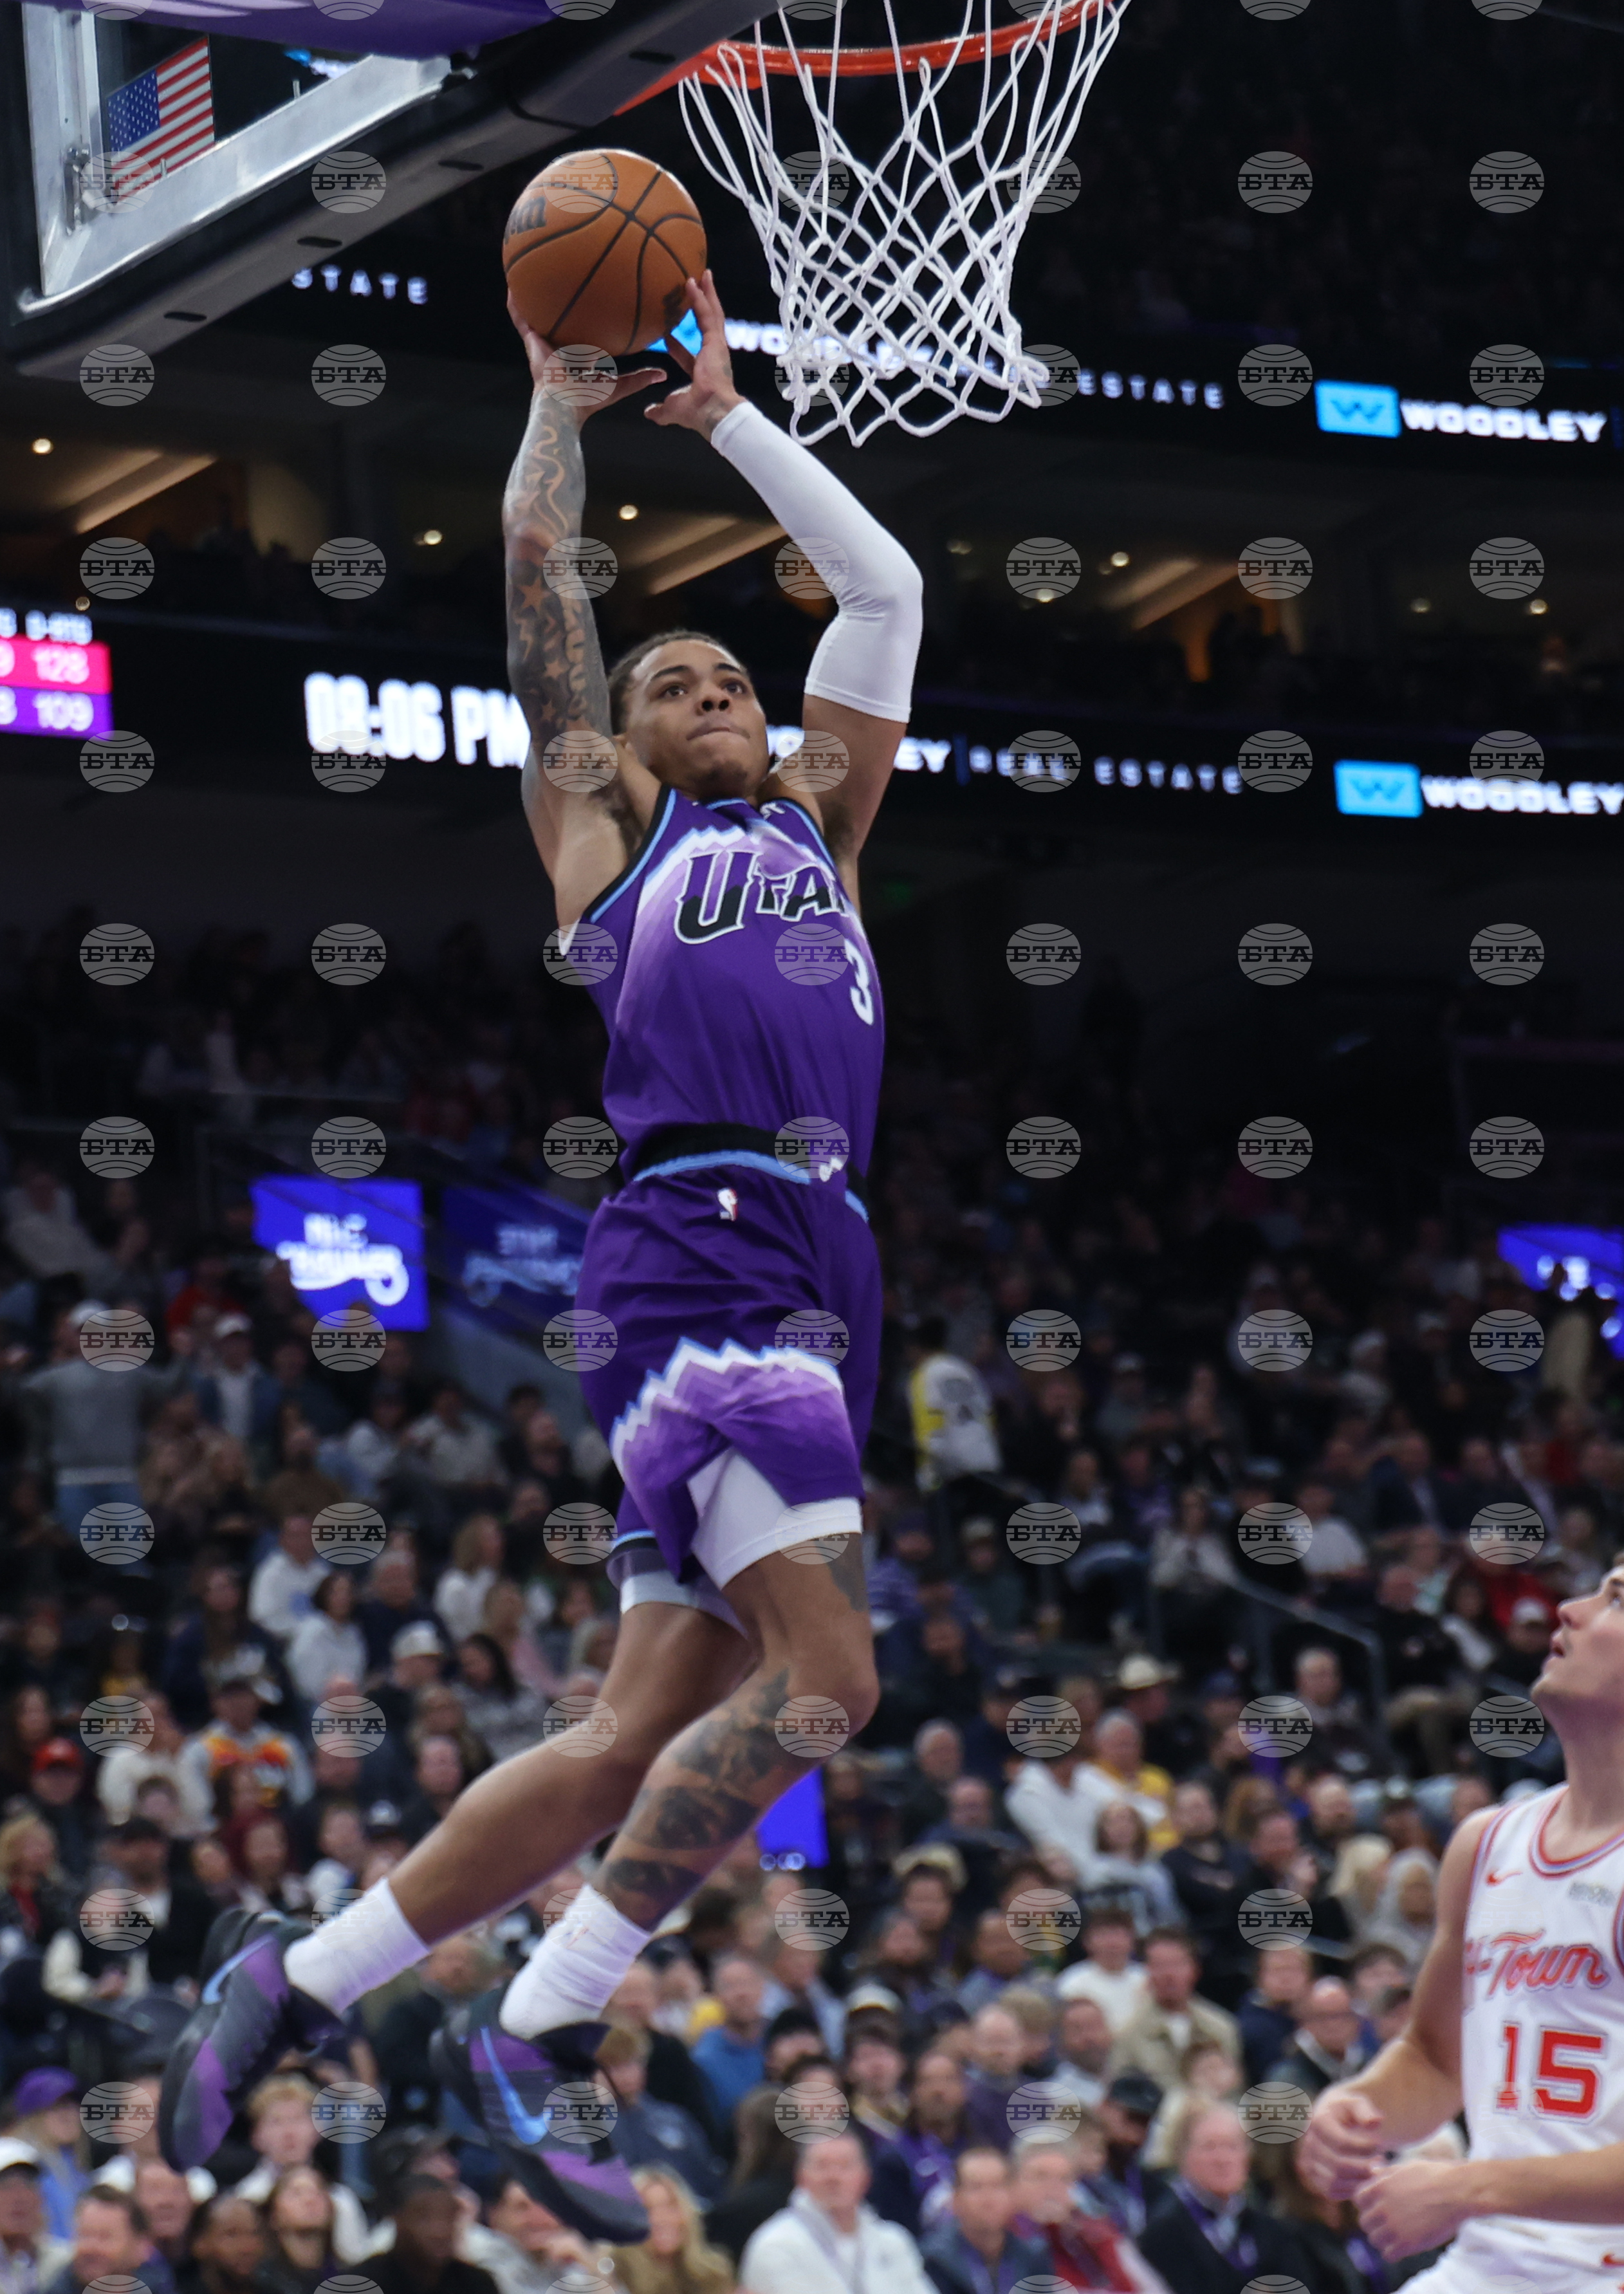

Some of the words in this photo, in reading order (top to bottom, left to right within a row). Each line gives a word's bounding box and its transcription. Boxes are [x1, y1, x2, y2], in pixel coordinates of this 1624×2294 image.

[1078, 368, 1224, 409] ESTATE
[1399, 400, 1607, 443] WOODLEY
[35, 690, 93, 732] 109
[304, 671, 446, 763] 08:06
[450, 685, 531, 770] PM
[1094, 755, 1243, 795] ESTATE
[1421, 775, 1624, 815] WOODLEY
[844, 939, 874, 1025] 3
[1493, 2022, 1607, 2123] 15
